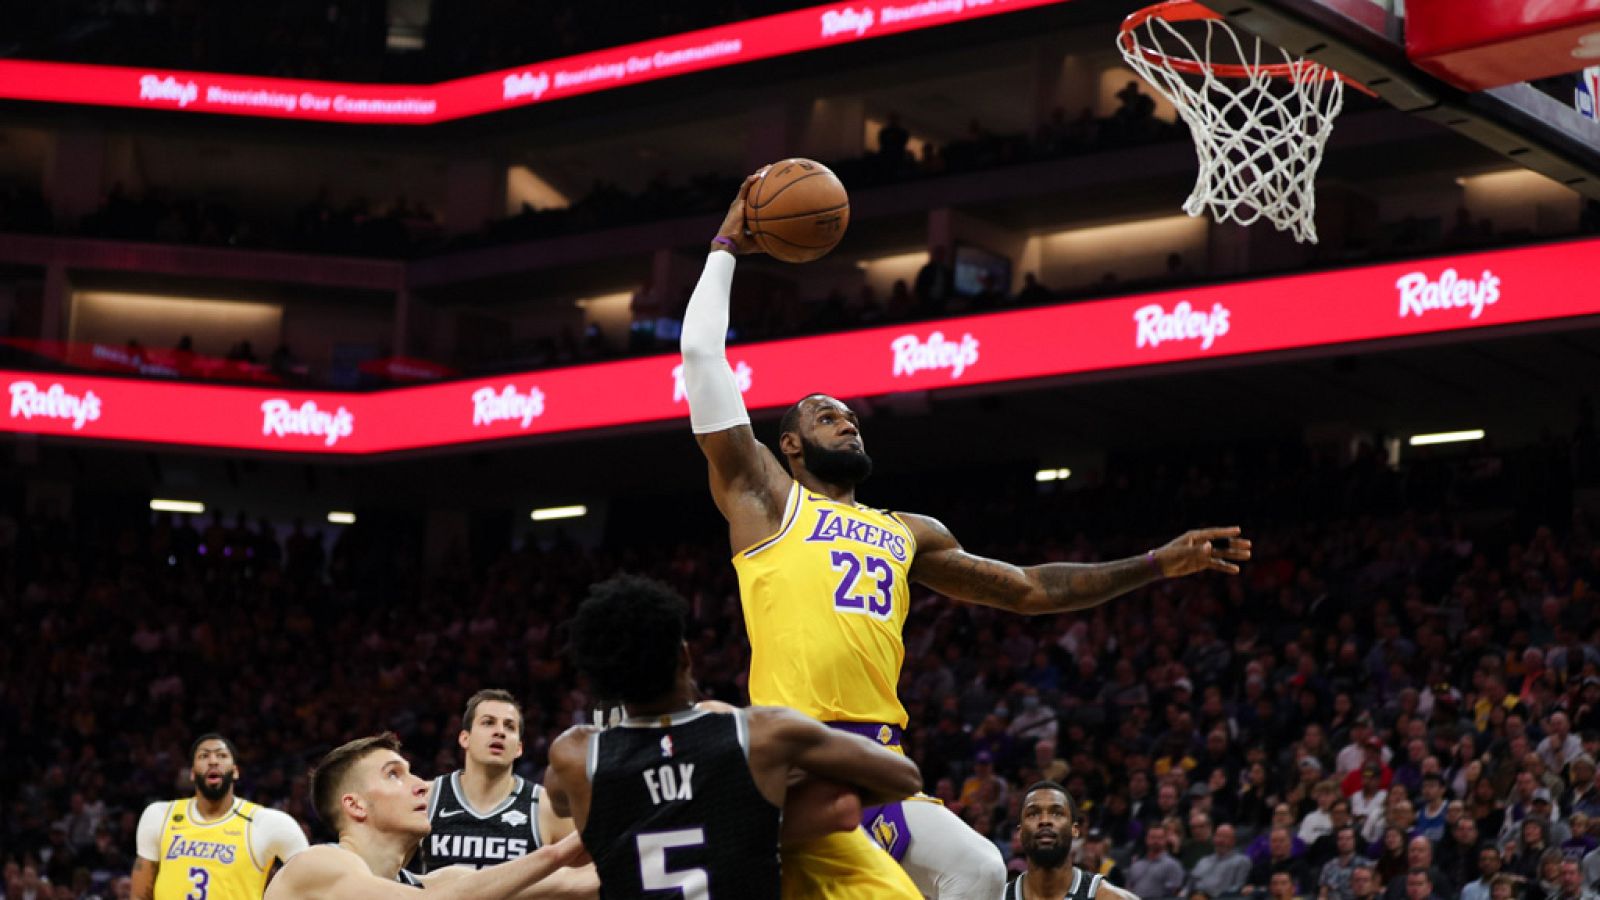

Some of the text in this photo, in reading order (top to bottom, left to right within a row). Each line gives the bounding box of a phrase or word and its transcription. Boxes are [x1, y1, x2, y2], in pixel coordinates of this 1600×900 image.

[1396, 268, 1501, 319] Raley's
[1133, 301, 1230, 350] Raley's
[891, 331, 979, 378] Raley's
[9, 380, 101, 430] Raley's
[260, 399, 353, 446] Raley's
[471, 384, 545, 428] Raley's
[805, 508, 907, 562] LAKERS
[830, 550, 894, 621] 23
[643, 763, 695, 805] FOX
[165, 834, 236, 865] LAKERS
[430, 833, 528, 860] KINGS
[637, 827, 709, 900] 5
[186, 866, 209, 900] 3
